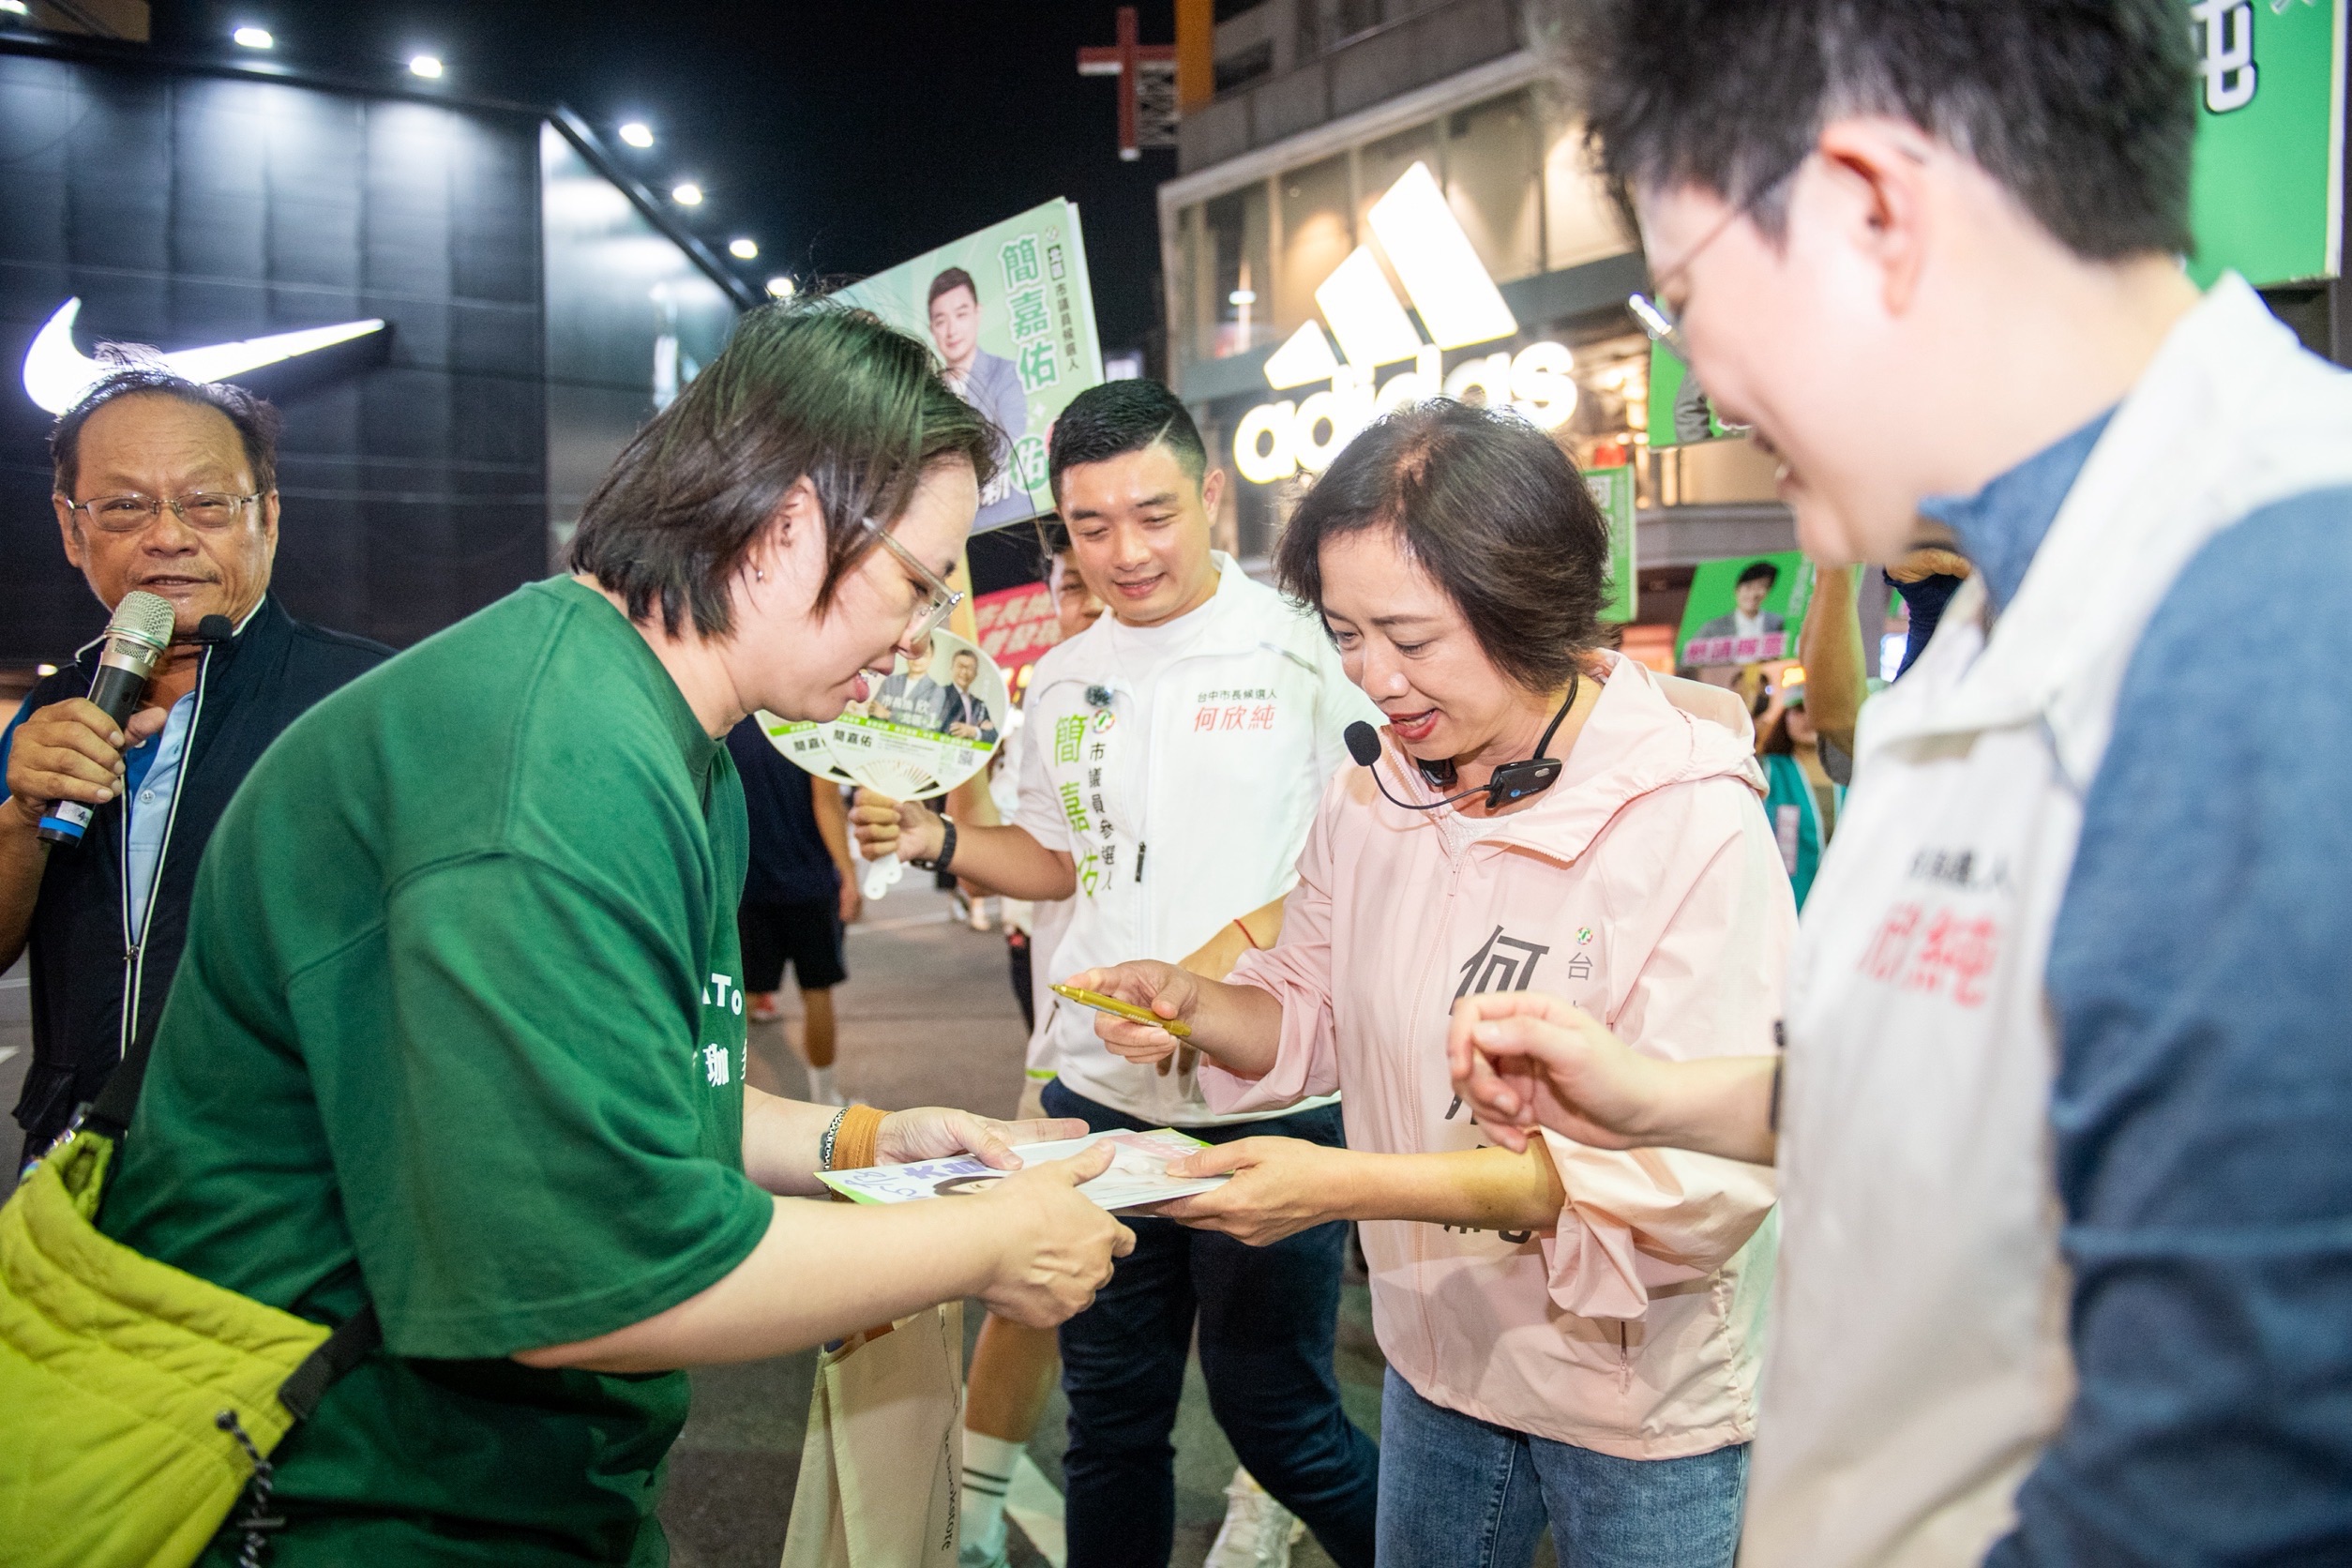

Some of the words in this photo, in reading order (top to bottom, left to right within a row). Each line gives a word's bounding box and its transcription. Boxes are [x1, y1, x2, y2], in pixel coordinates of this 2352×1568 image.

[1000, 235, 1059, 392] 簡嘉佑
[1233, 341, 1578, 484] adidas
[1194, 704, 1275, 732] 何欣純
[1197, 688, 1277, 702] 台中市長候選人
[793, 737, 826, 752] 簡嘉
[1089, 742, 1115, 891] 市議員參選人
